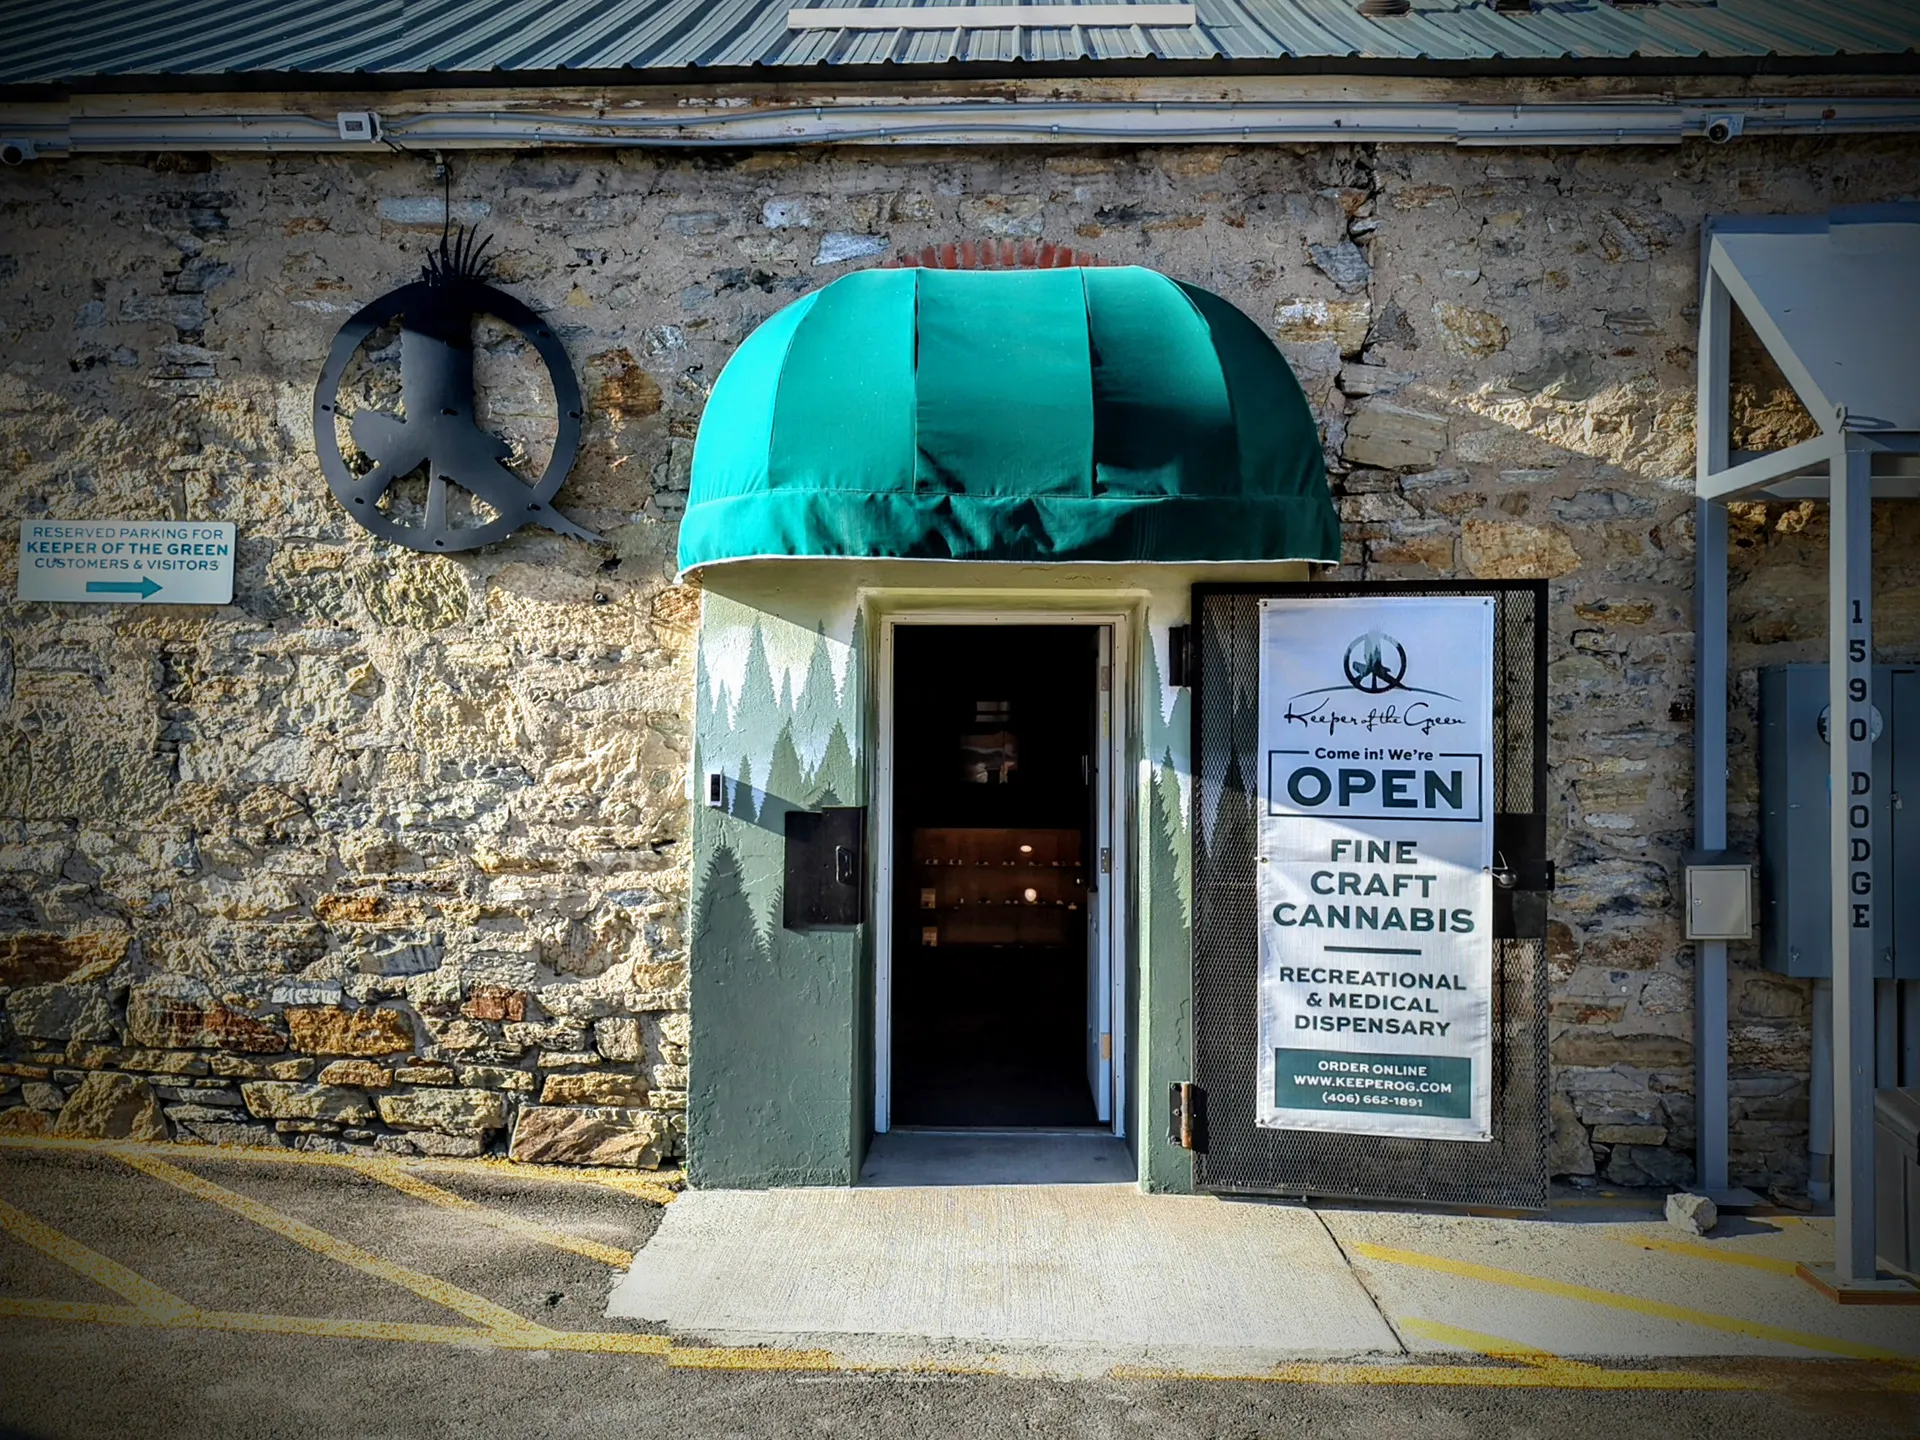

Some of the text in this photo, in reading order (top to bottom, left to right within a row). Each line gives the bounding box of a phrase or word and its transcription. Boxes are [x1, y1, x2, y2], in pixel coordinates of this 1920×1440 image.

[33, 526, 224, 540] RESERVED PARKING FOR
[26, 541, 228, 556] KEEPER OF THE GREEN
[34, 557, 221, 571] CUSTOMERS & VISITORS
[1283, 697, 1466, 736] Keeper of the Green
[1314, 747, 1361, 761] Come
[1364, 747, 1384, 761] in!
[1848, 599, 1872, 929] 1590 DODGE
[1287, 766, 1463, 810] OPEN
[1330, 838, 1418, 865] FINE
[1310, 870, 1438, 899] CRAFT
[1272, 902, 1475, 935] CANNABIS
[1279, 966, 1467, 991] RECREATIONAL
[1305, 992, 1439, 1014] & MEDICAL
[1294, 1014, 1452, 1037] DISPENSARY
[1317, 1060, 1428, 1077] ORDER ONLINE
[1293, 1074, 1452, 1094] WWW.KEEPEROG.COM
[1322, 1091, 1424, 1108] (406) 662-1891
